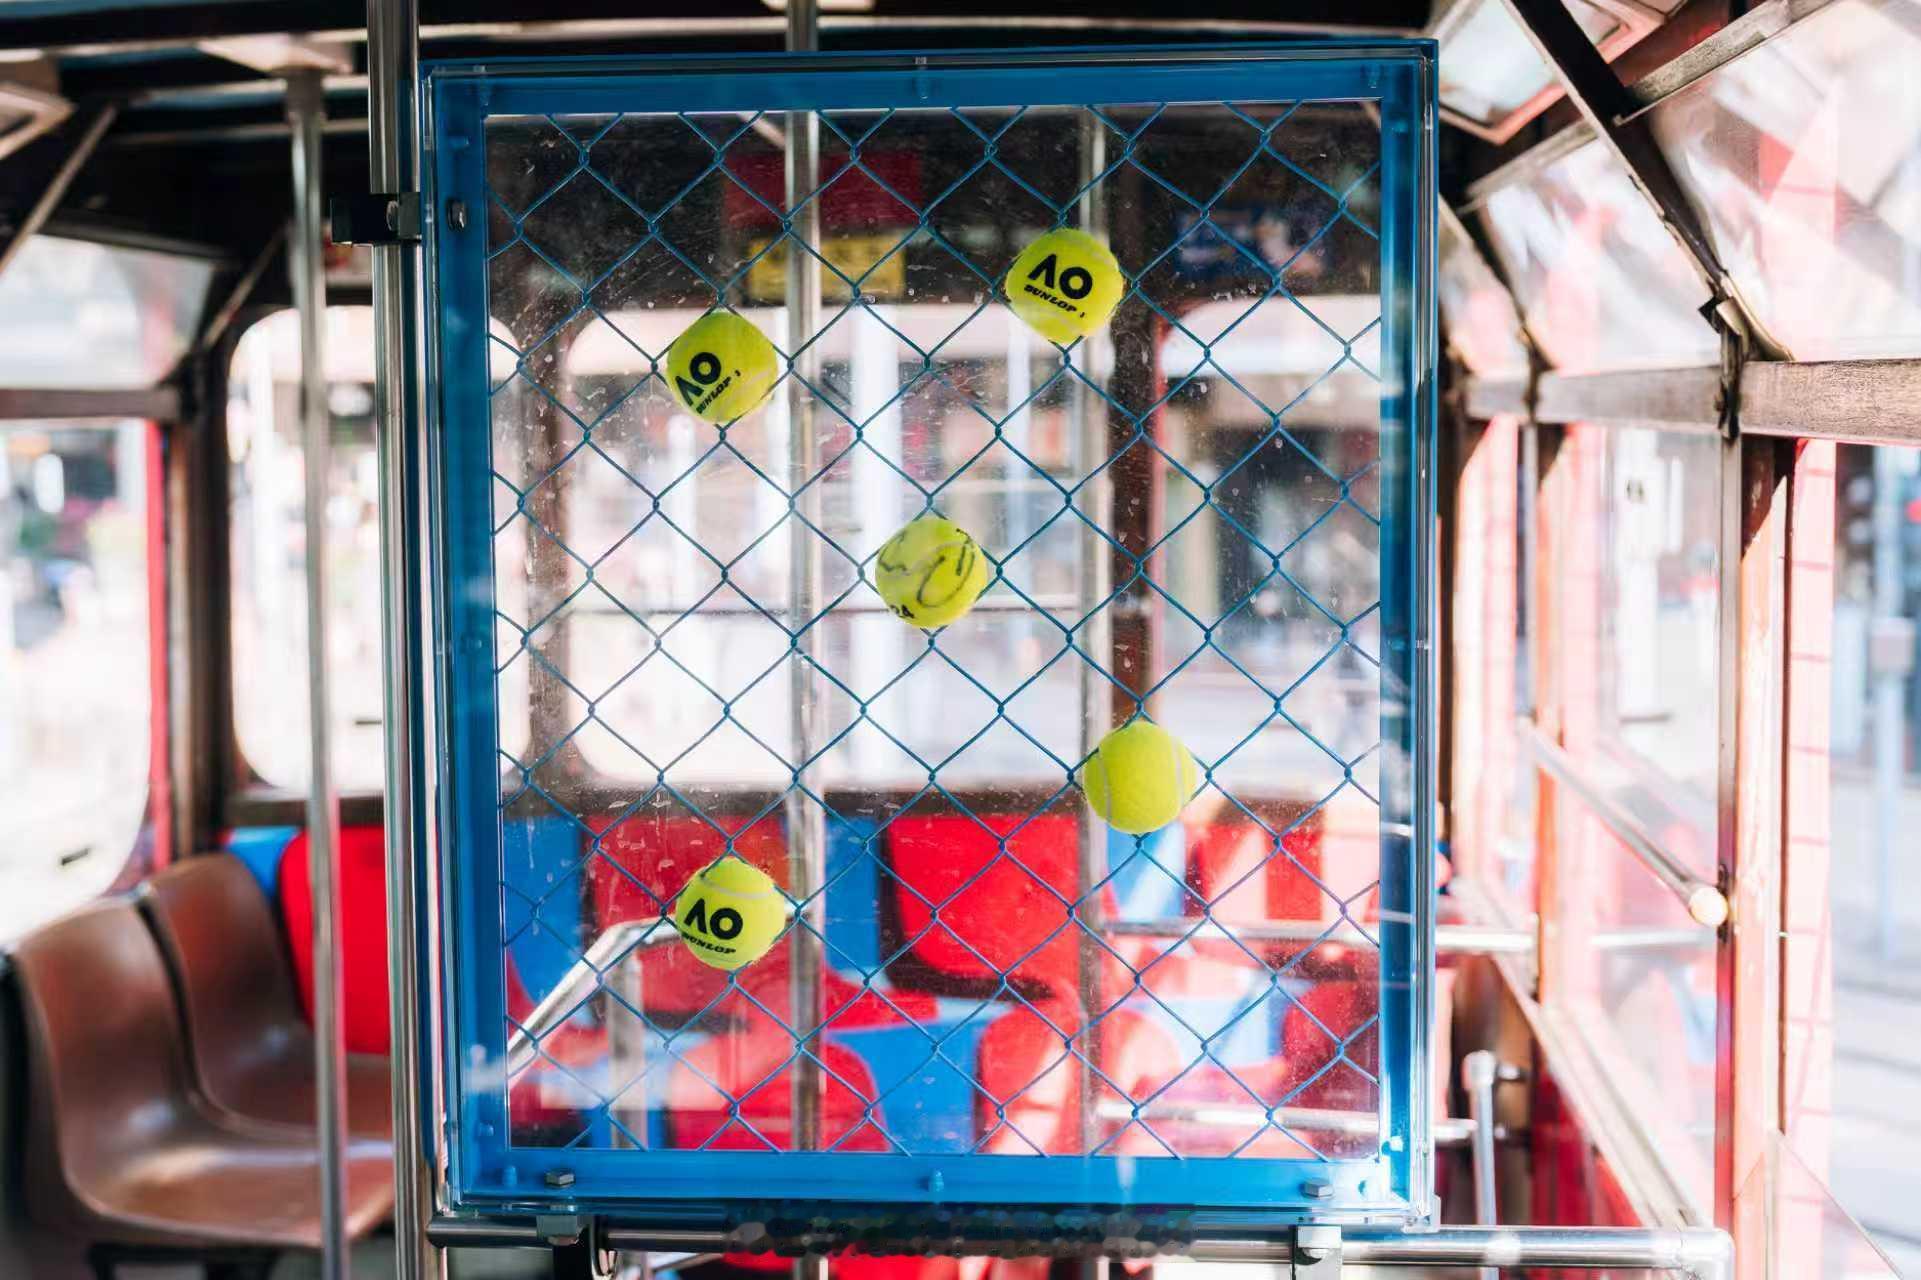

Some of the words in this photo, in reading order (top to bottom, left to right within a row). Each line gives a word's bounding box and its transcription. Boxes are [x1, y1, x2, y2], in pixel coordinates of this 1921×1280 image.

[1024, 284, 1077, 312] DUNLOP
[1027, 253, 1093, 300] AO
[675, 351, 721, 406] AO
[684, 897, 743, 940] AO
